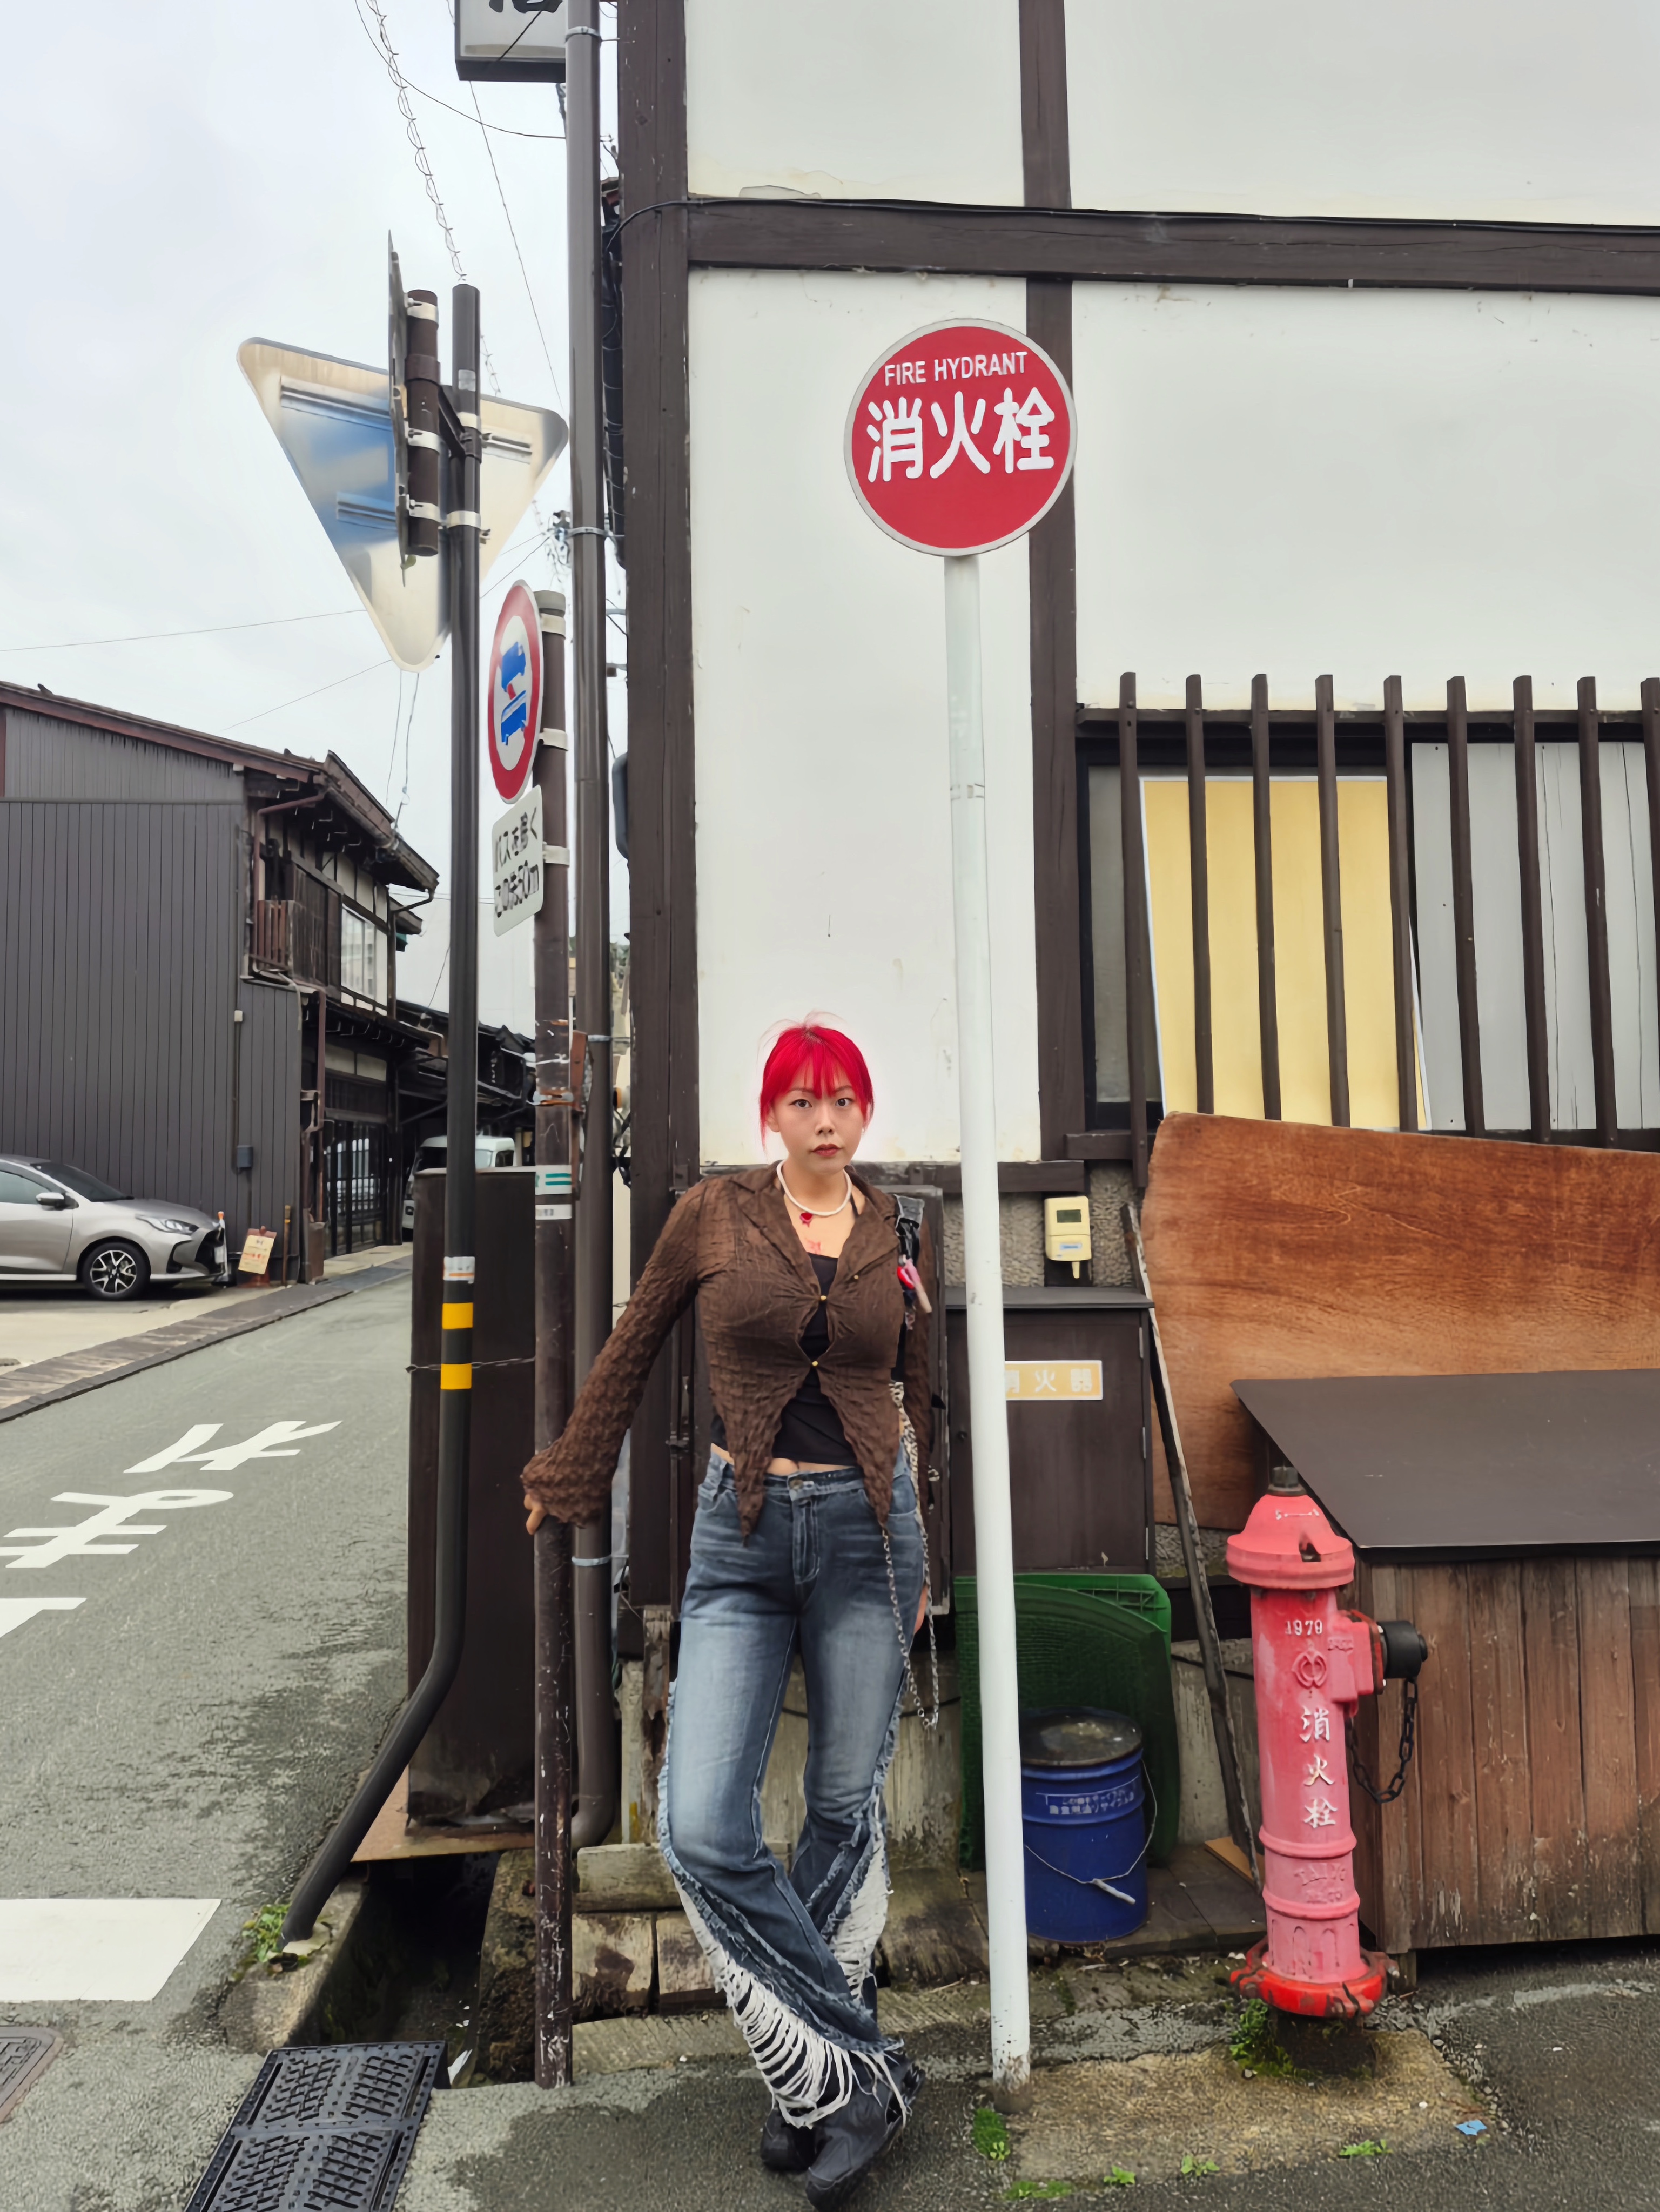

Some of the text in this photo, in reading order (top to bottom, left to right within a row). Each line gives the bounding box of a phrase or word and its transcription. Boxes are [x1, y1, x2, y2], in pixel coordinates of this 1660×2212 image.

[885, 351, 1027, 386] FIRE HYDRANT
[866, 387, 1055, 482] 消火栓
[1285, 1619, 1323, 1636] 1979
[1300, 1705, 1338, 1829] 消火栓
